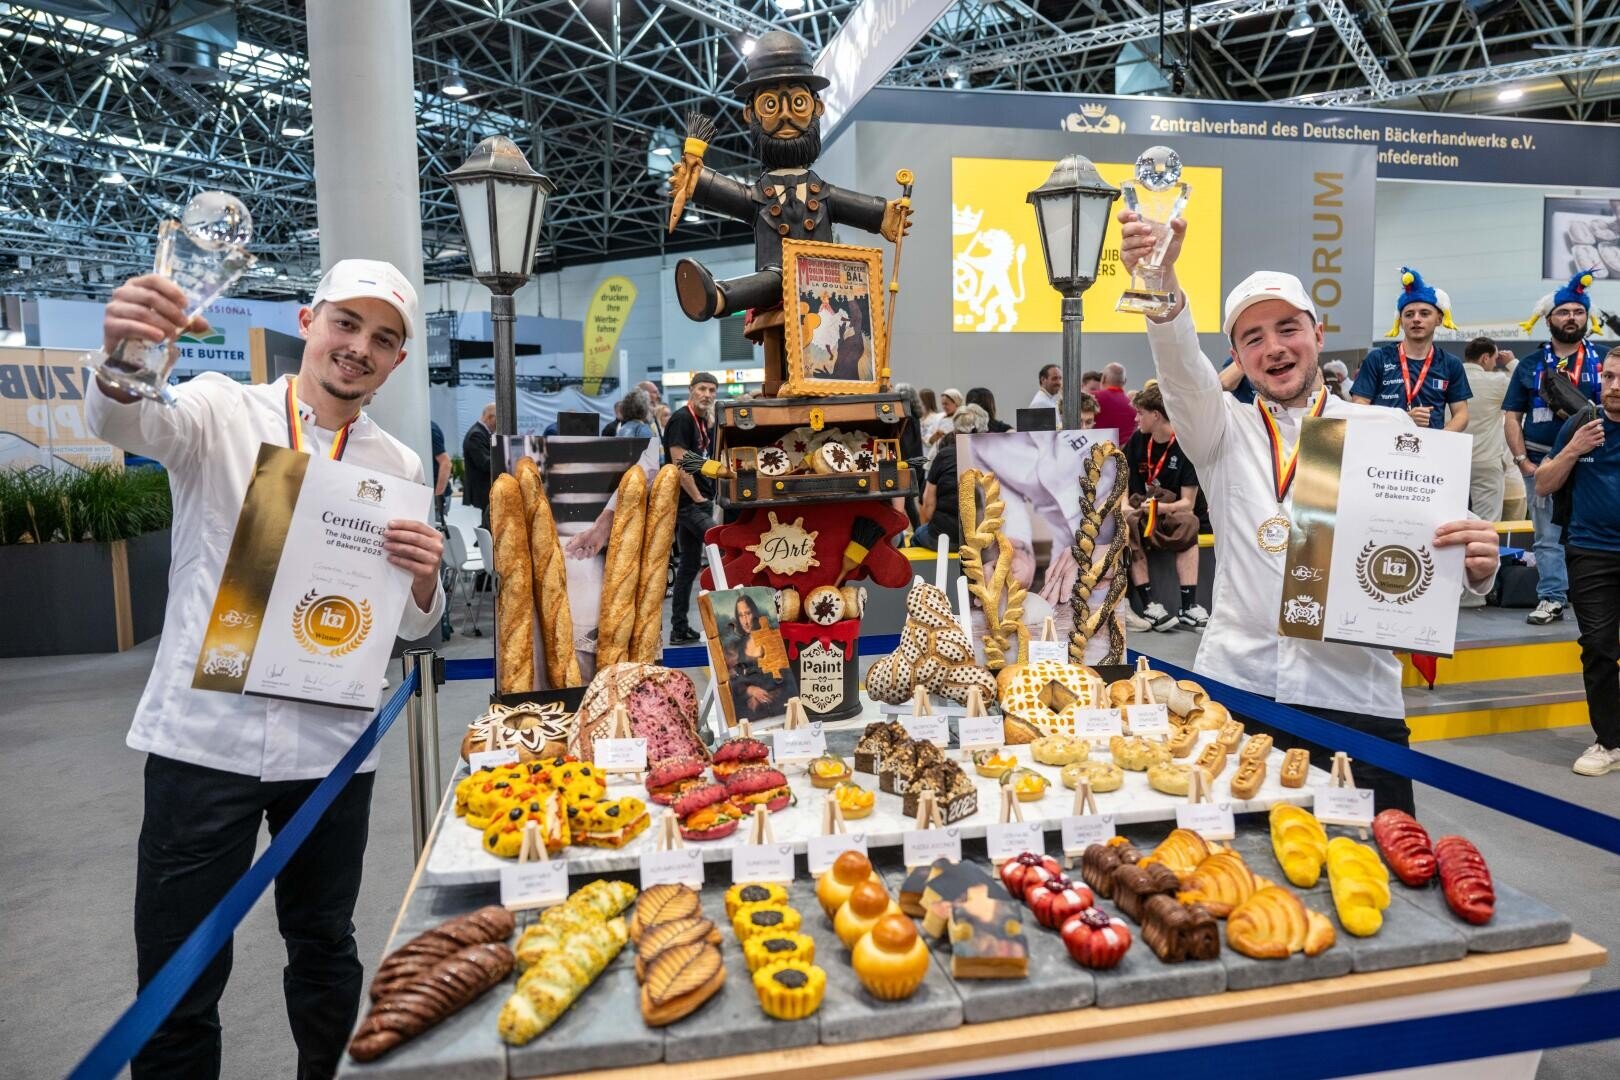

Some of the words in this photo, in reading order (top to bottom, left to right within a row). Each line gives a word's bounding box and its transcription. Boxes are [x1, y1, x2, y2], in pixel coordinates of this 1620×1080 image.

[1150, 115, 1267, 136] Zentralverband
[1272, 121, 1298, 137] des
[1303, 123, 1380, 141] Deutschen
[1385, 127, 1508, 149] Bäckerhandwerks
[1511, 134, 1536, 150] e.V.
[1101, 249, 1120, 261] UIB
[1312, 172, 1344, 333] FORUM
[846, 271, 863, 282] BAL
[609, 285, 622, 293] Wir
[822, 282, 853, 290] GOULUE
[607, 304, 620, 312] Ihre
[198, 349, 245, 360] BUTTER
[1367, 466, 1444, 486] Certificate
[1372, 482, 1385, 490] The
[1400, 485, 1418, 493] UIBC
[1420, 487, 1436, 495] CUP
[1384, 492, 1409, 501] Bakers
[1411, 494, 1431, 502] 2025
[322, 510, 385, 536] Certifica
[325, 528, 339, 538] The
[340, 531, 351, 541] iba
[353, 535, 372, 545] UIBC
[373, 540, 384, 548] CU
[335, 540, 361, 552] Bakers
[362, 547, 382, 556] 2025
[764, 536, 808, 562] Art
[1382, 557, 1407, 577] iba
[320, 607, 346, 629] iba
[803, 661, 841, 673] Paint
[812, 683, 833, 692] Red
